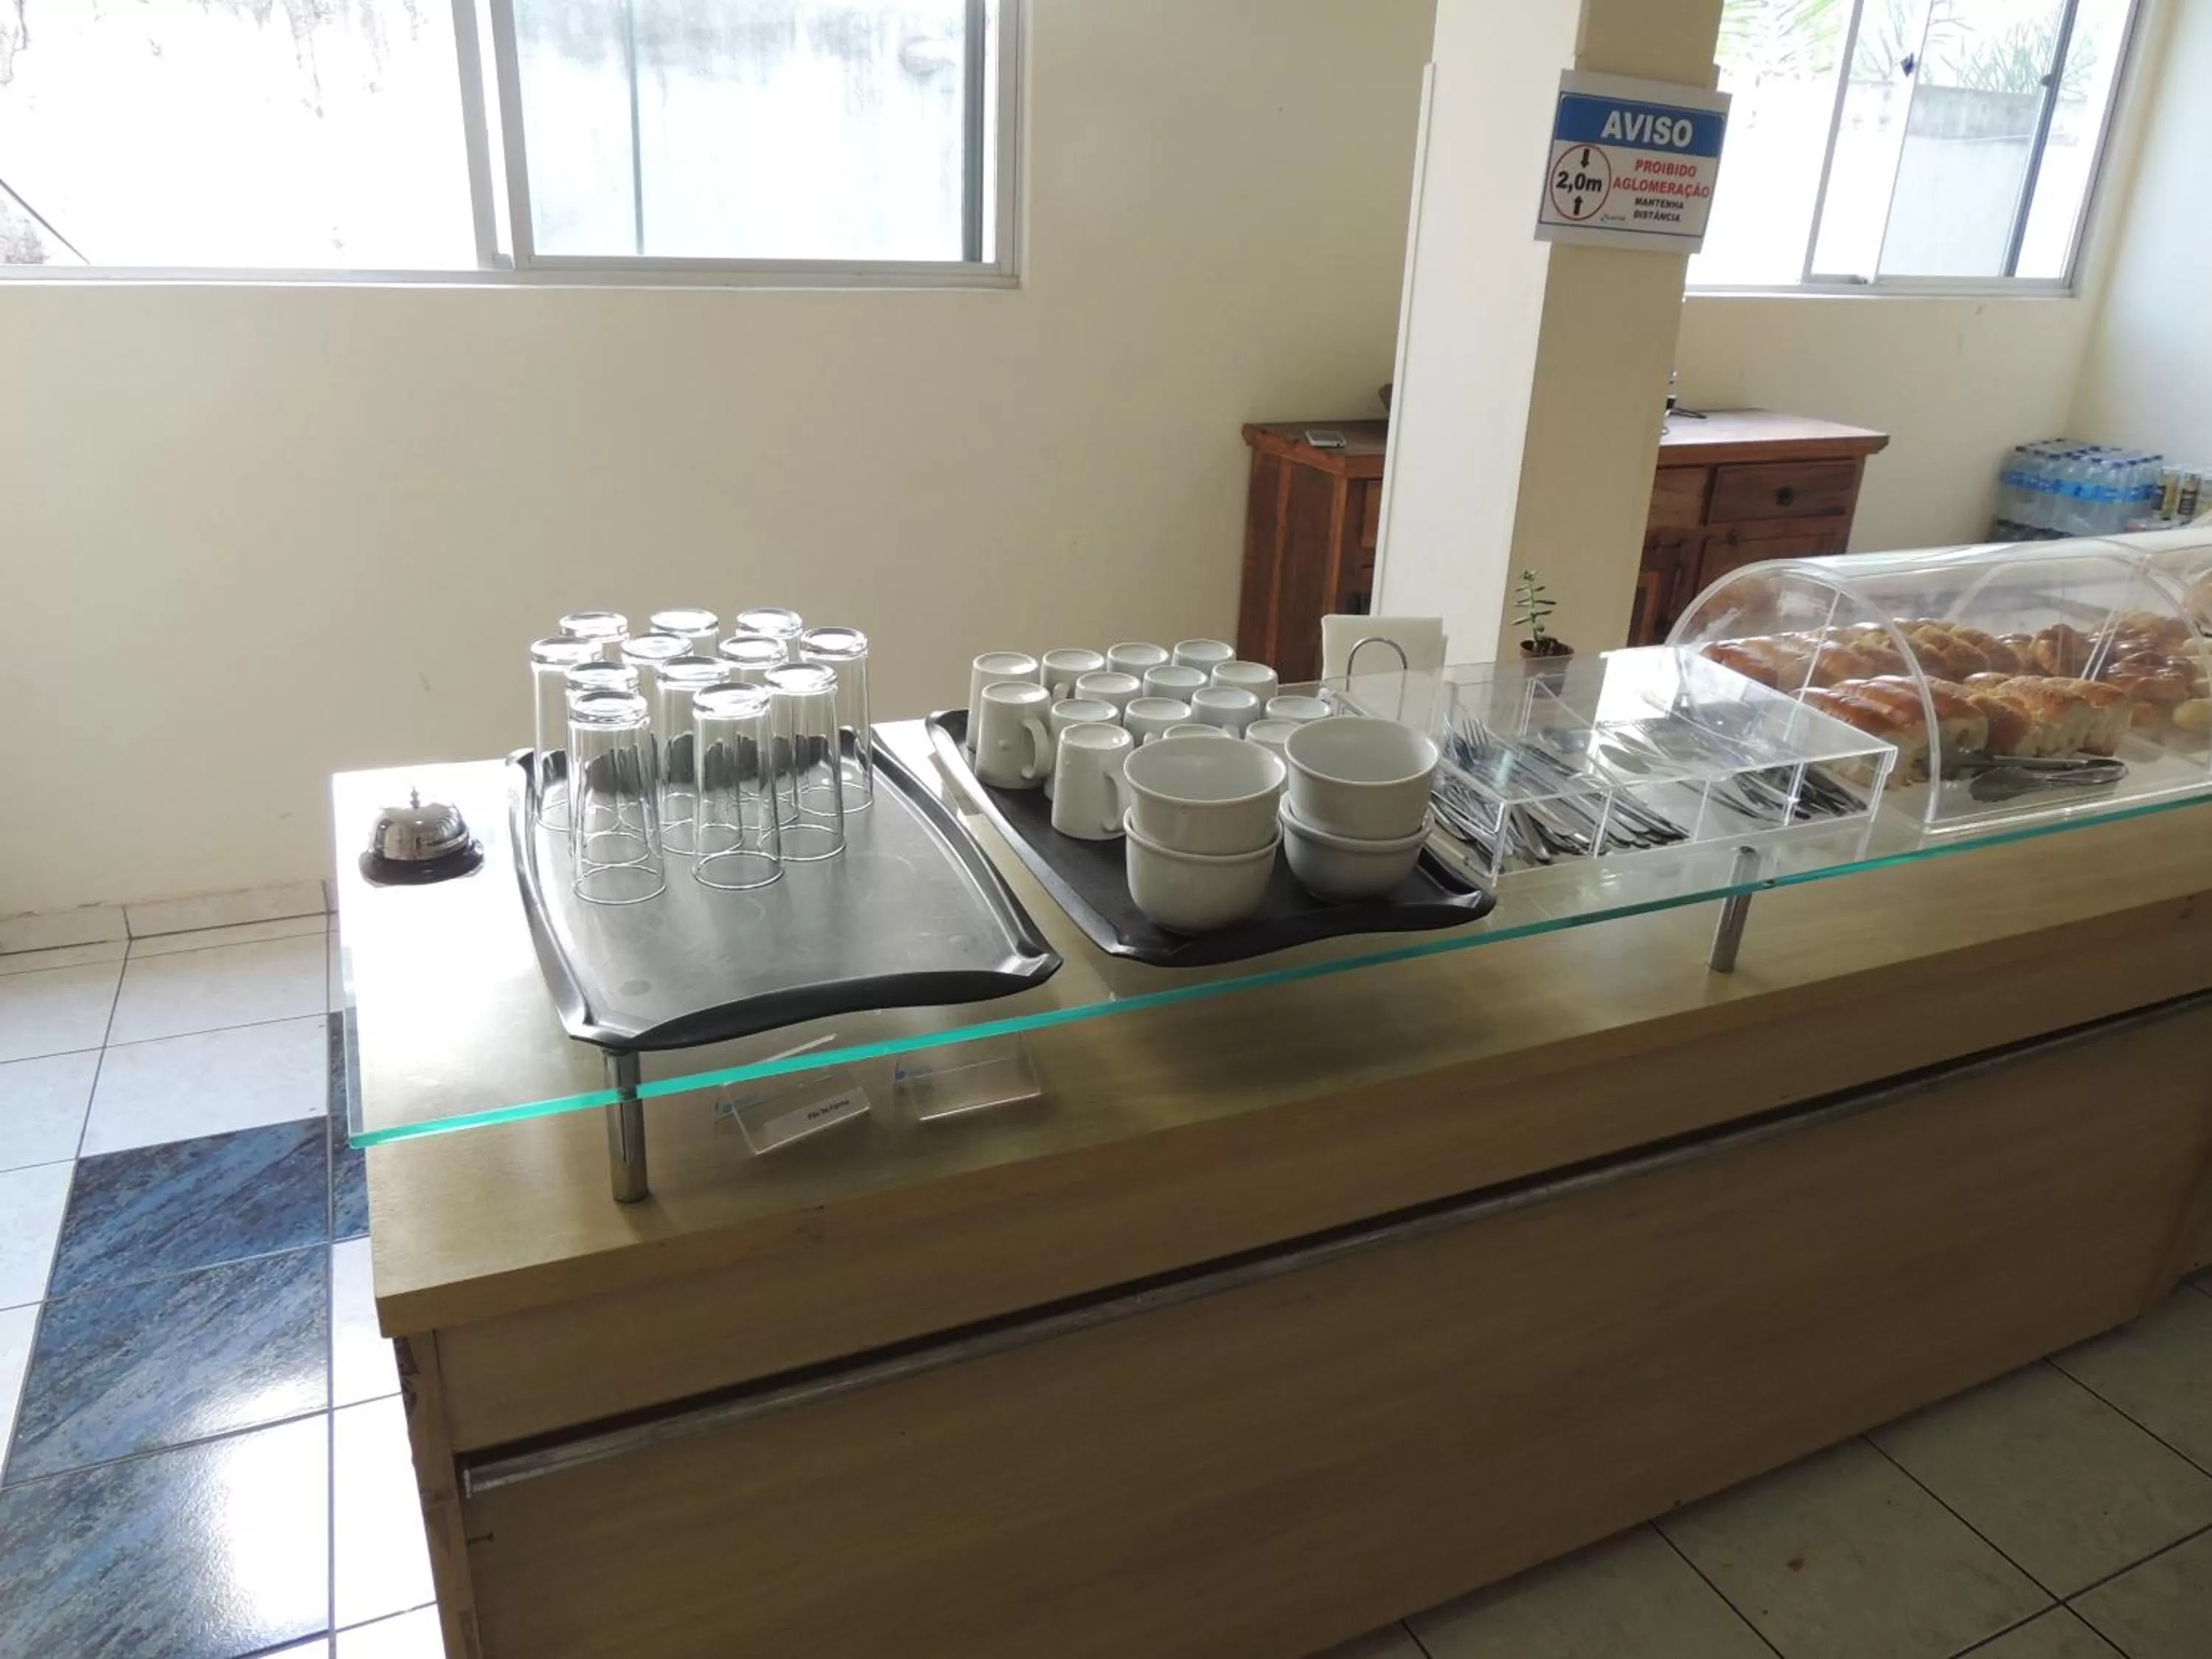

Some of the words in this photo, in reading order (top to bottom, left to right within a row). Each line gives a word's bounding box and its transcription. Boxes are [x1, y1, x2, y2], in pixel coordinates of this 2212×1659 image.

[1601, 110, 1694, 147] AVISO
[1635, 159, 1698, 178] PROIBIDO
[1556, 170, 1603, 194] 2,0m
[1613, 176, 1711, 199] AGLOMERAÇÃO
[1635, 197, 1684, 209] MANTENHA
[1633, 209, 1680, 221] DISTÂNCIA
